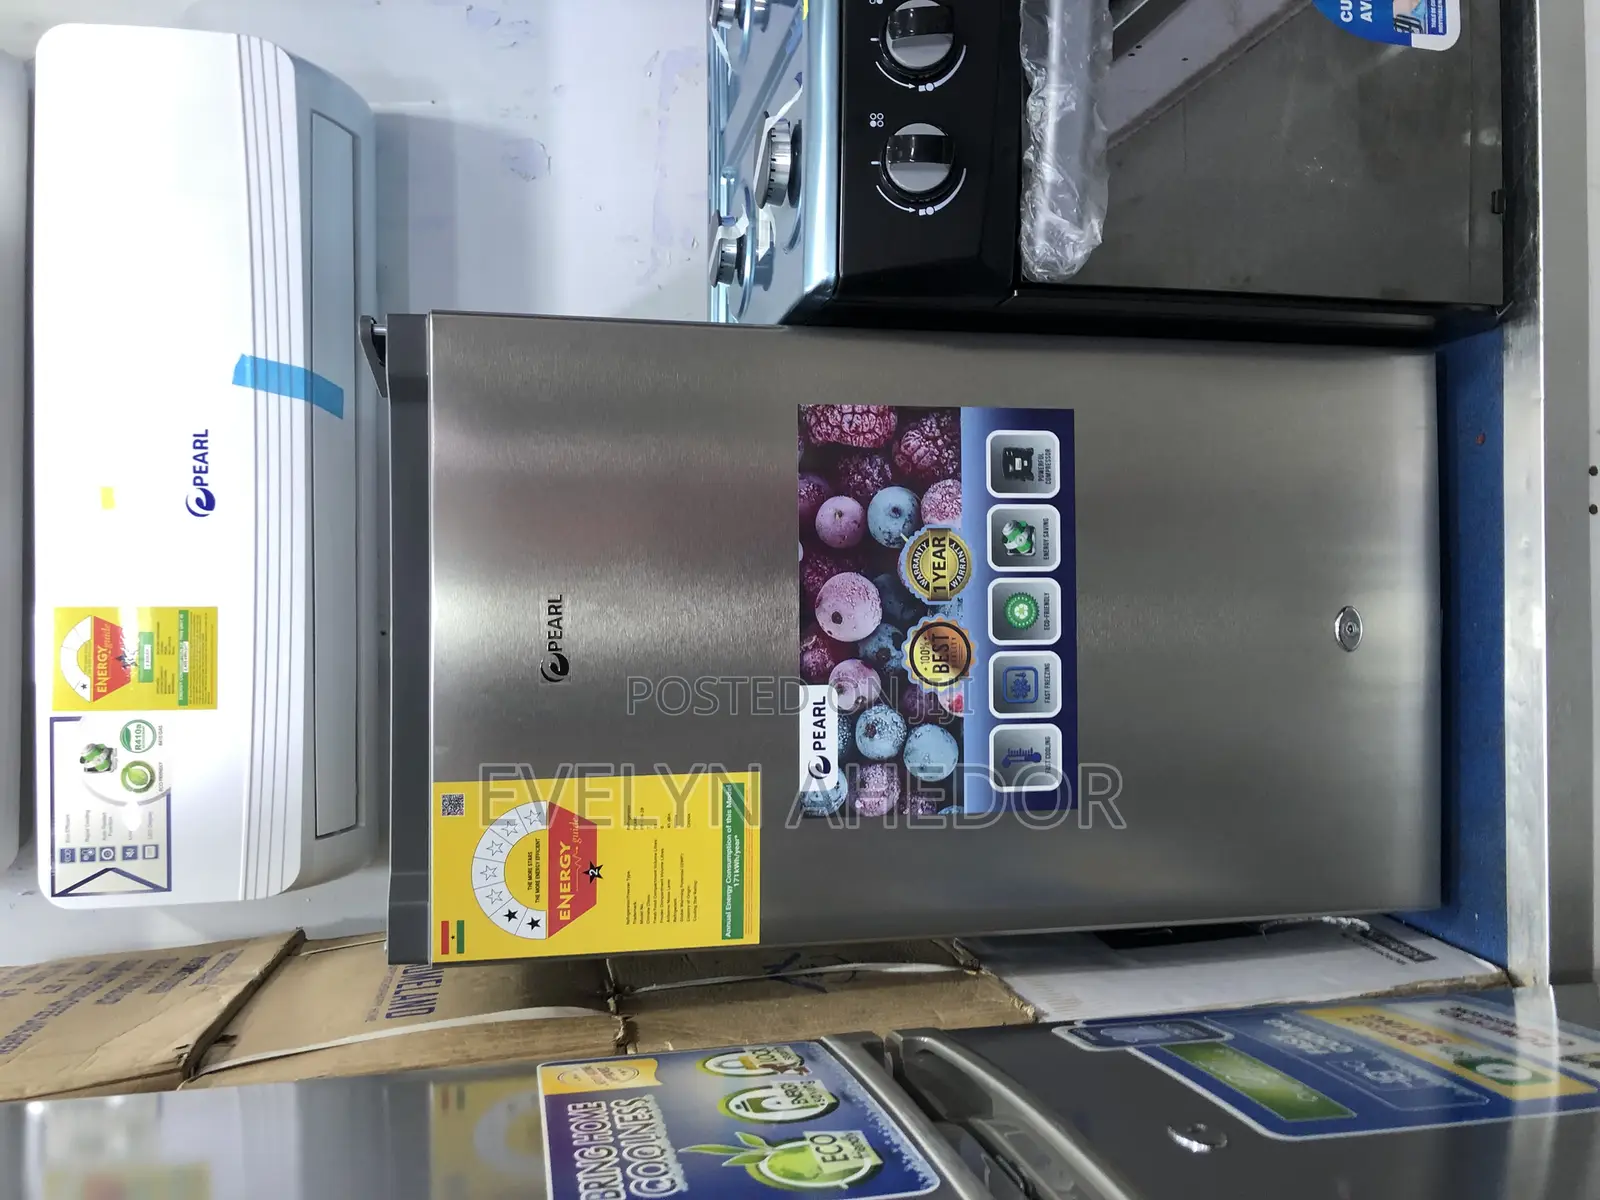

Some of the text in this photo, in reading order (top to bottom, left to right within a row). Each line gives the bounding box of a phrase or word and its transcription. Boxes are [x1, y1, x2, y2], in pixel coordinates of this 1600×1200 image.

[1360, 0, 1372, 23] AV
[192, 428, 209, 487] PEARL
[912, 542, 928, 587] WARRANTY
[932, 537, 946, 582] YEAR
[950, 542, 966, 588] WARRANTY
[547, 594, 563, 652] PEARL
[95, 623, 113, 693] ENERGY guide
[920, 642, 930, 664] 100%
[932, 634, 949, 673] BEST
[812, 696, 826, 751] PEARL
[726, 825, 731, 833] of
[557, 817, 582, 920] ENERGY guide
[725, 885, 733, 910] Energy
[567, 1101, 615, 1145] HOME
[610, 1095, 680, 1197] COOLNESS
[809, 1134, 851, 1163] ECO
[574, 1146, 627, 1200] BRING
